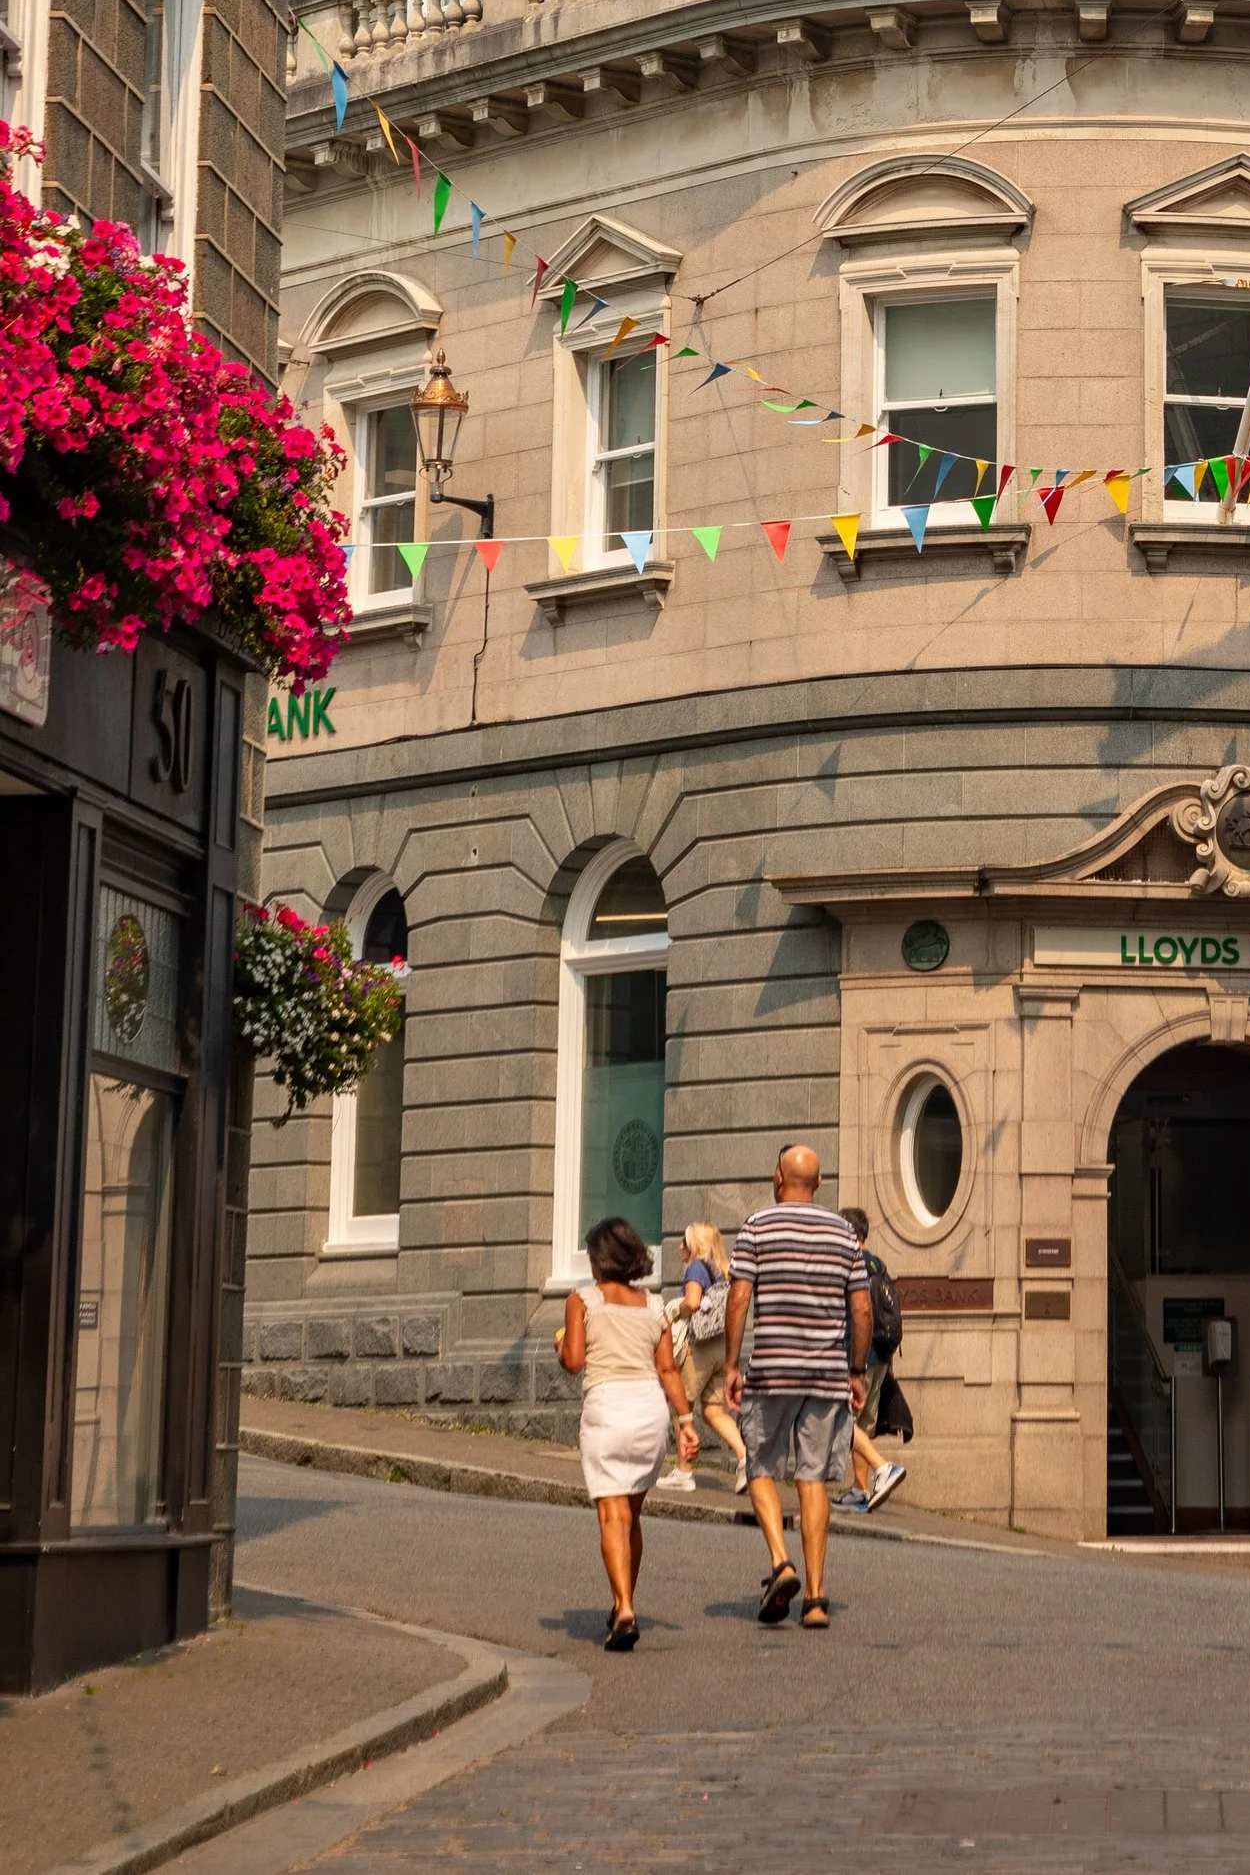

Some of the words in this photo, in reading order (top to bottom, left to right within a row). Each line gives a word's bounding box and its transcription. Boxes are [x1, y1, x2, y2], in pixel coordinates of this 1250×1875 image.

[150, 669, 193, 794] 50
[1120, 935, 1241, 966] LLOYDS
[934, 1288, 979, 1304] BANK
